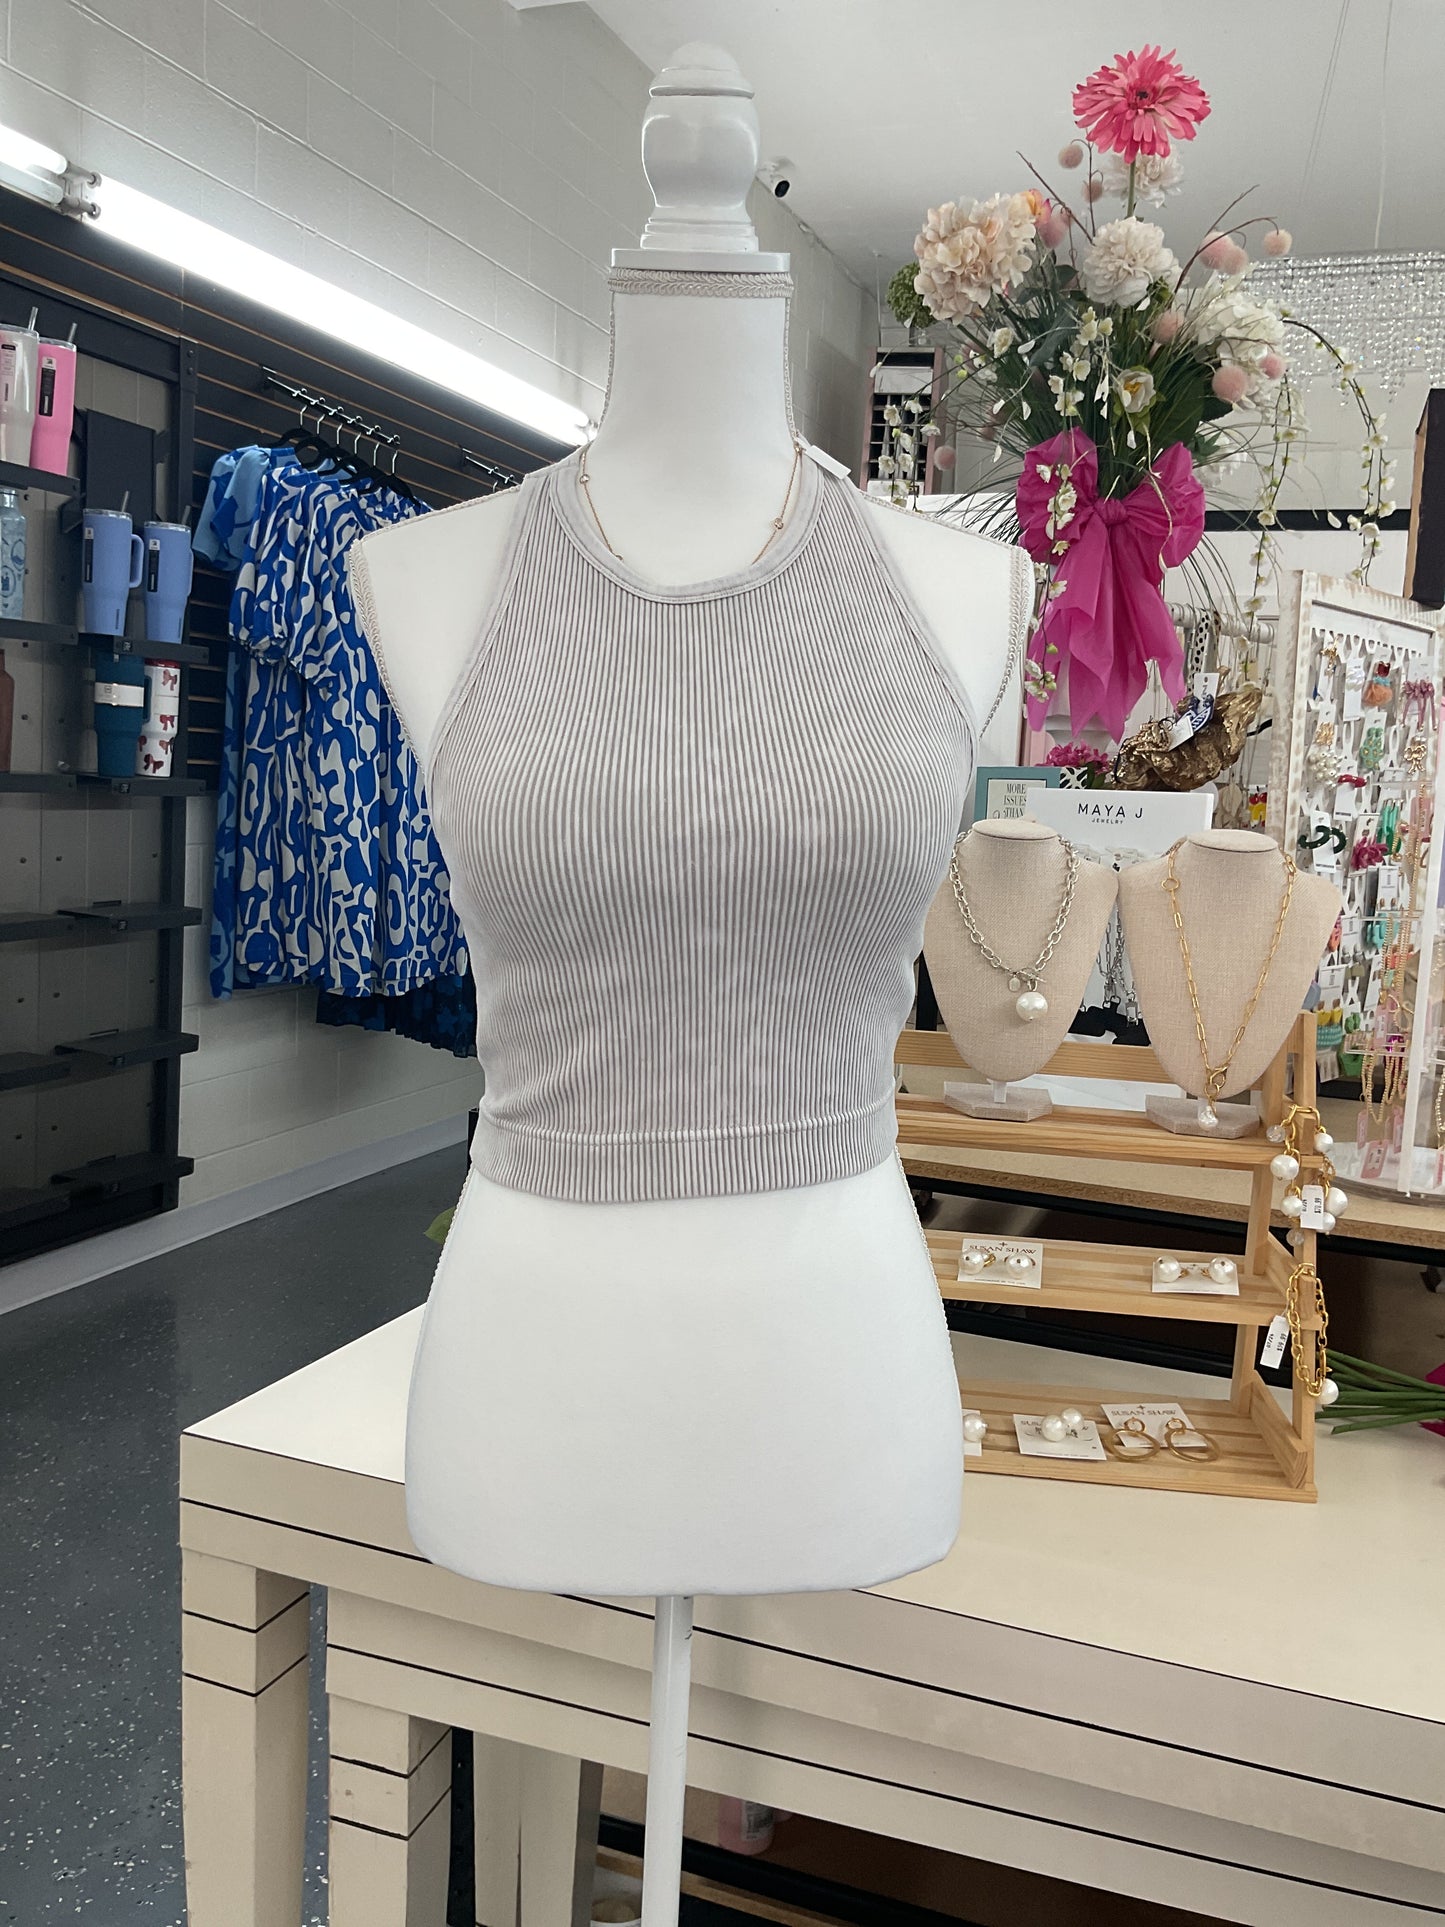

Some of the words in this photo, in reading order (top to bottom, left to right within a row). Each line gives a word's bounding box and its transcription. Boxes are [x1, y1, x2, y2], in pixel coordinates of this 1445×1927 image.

[1007, 783, 1027, 794] MORE
[1078, 803, 1126, 818] MAYA
[1135, 807, 1143, 819] J
